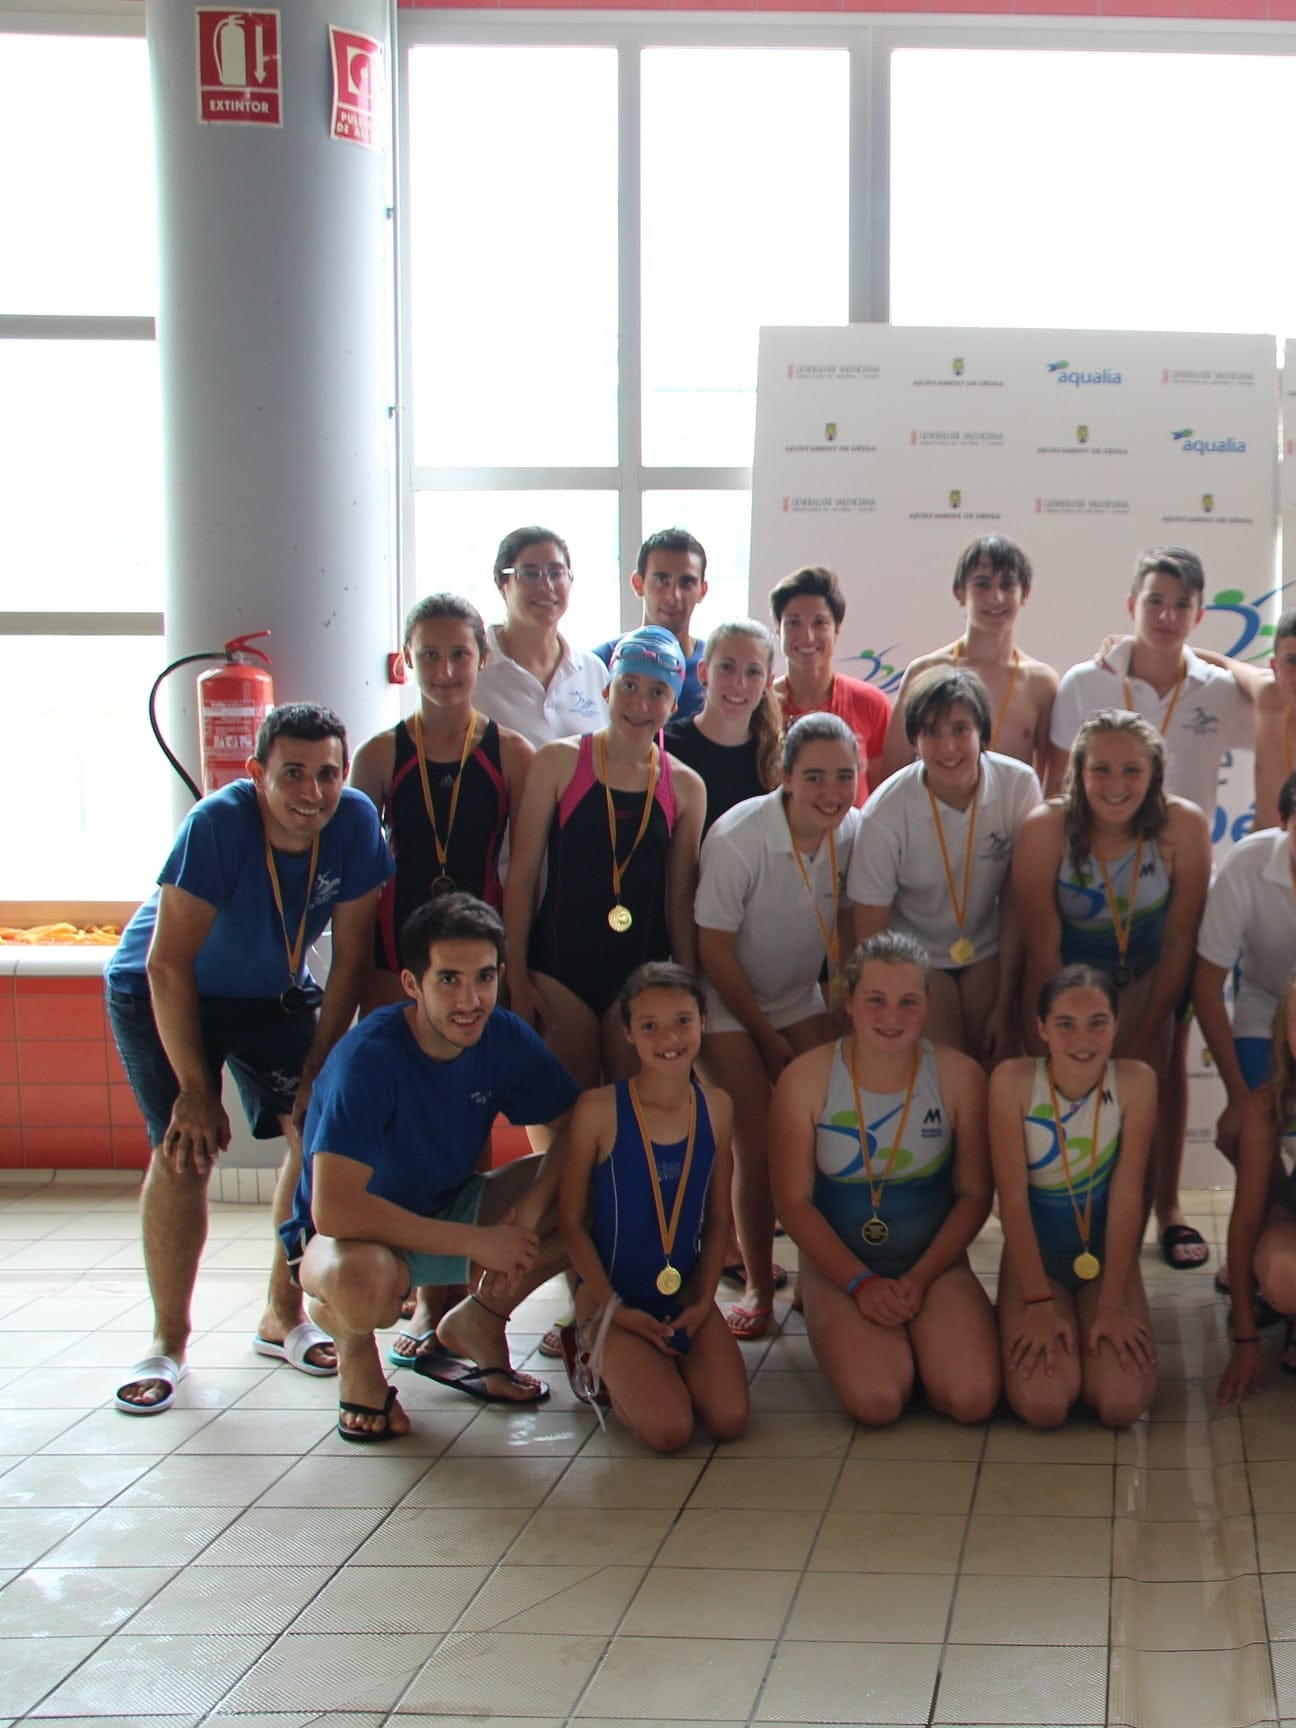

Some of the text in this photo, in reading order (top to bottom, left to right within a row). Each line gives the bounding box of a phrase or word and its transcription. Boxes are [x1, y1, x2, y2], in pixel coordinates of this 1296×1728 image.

[210, 98, 270, 114] EXTINTOR
[1058, 368, 1122, 387] aqualia
[1182, 436, 1246, 455] aqualia
